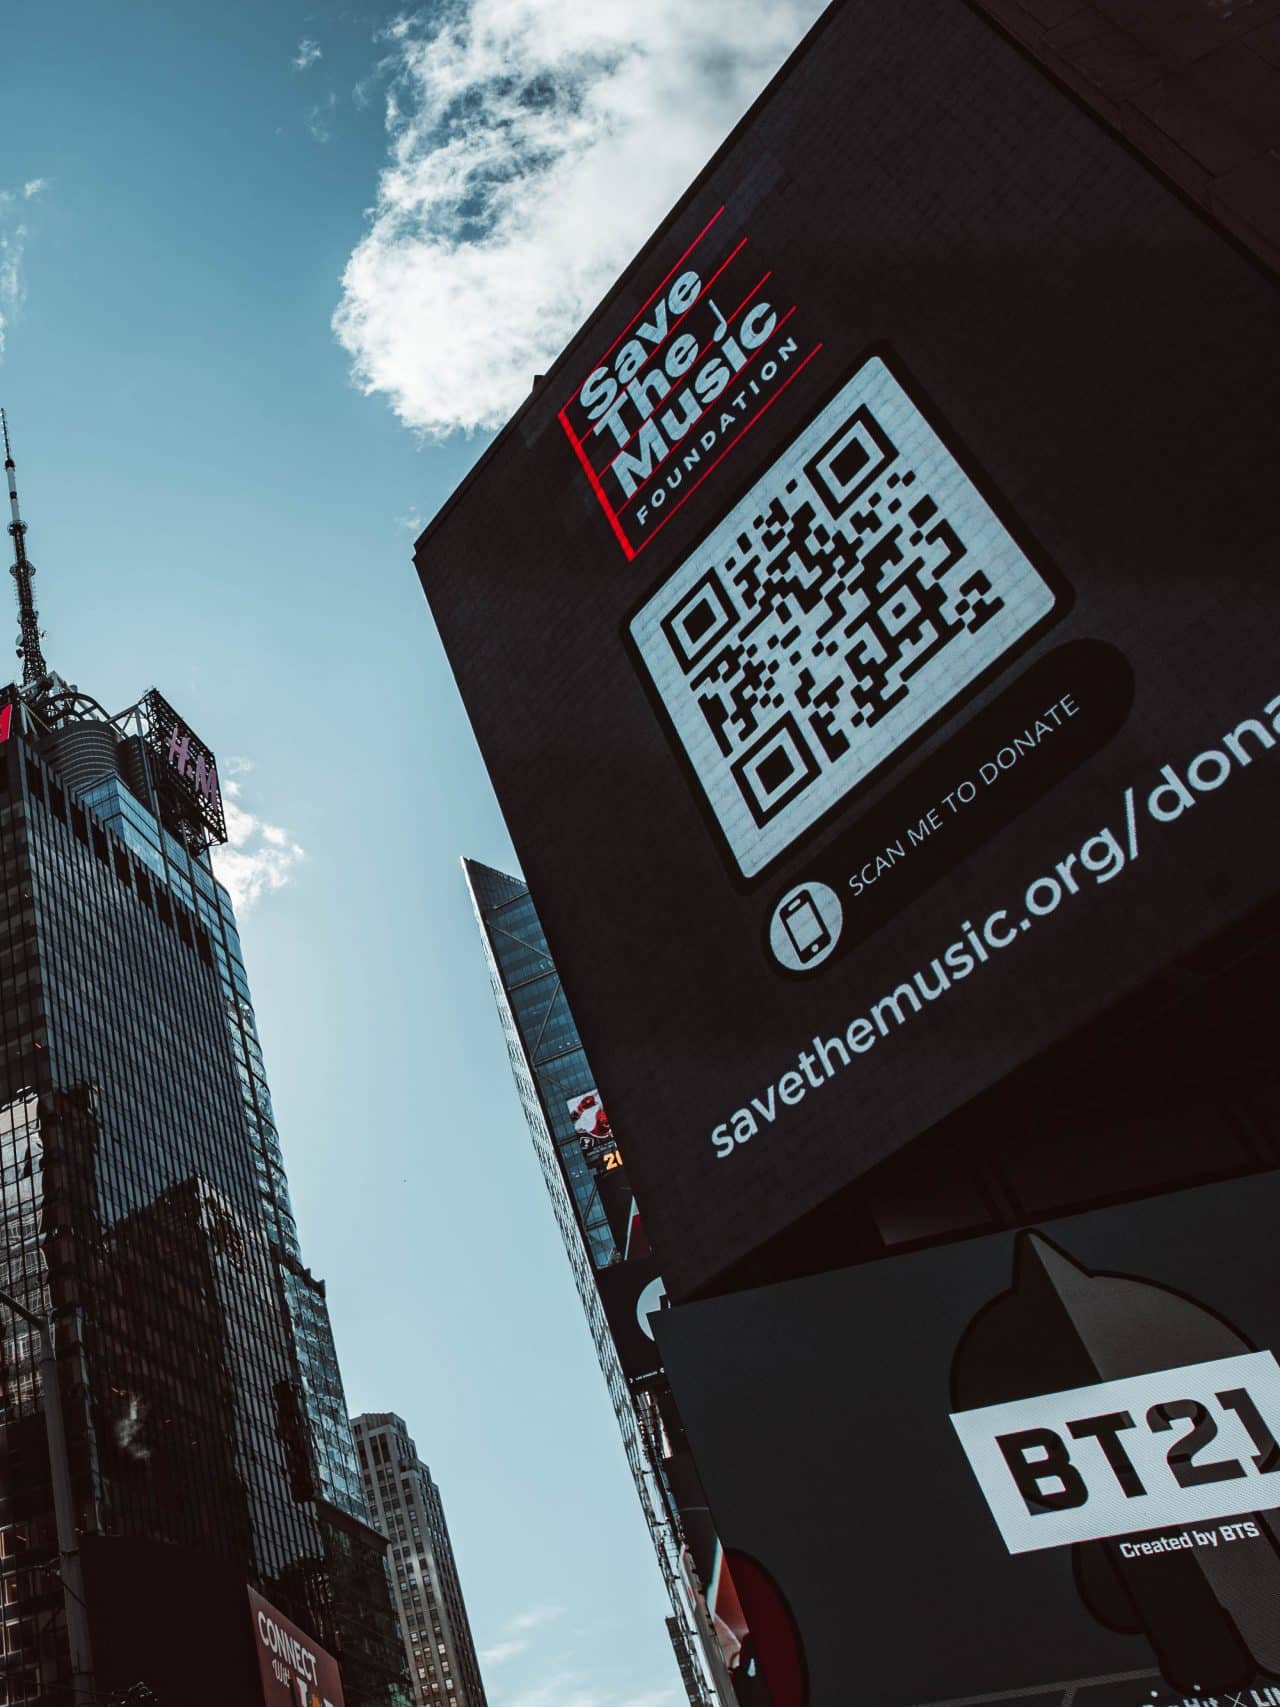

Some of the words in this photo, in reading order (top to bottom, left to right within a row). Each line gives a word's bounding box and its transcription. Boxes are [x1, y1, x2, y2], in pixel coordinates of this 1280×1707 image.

[579, 271, 701, 421] Save
[593, 334, 699, 448] The
[610, 302, 777, 499] Music
[636, 337, 799, 525] FOUNDATION
[848, 840, 906, 896] SCAN
[907, 809, 943, 848] ME
[941, 781, 977, 815] TO
[979, 694, 1080, 785] DONATE
[994, 1387, 1280, 1517] BT21
[1120, 1531, 1193, 1559] Created
[1192, 1530, 1218, 1547] by
[1218, 1521, 1261, 1542] BTS
[258, 1611, 317, 1687] CONNECT
